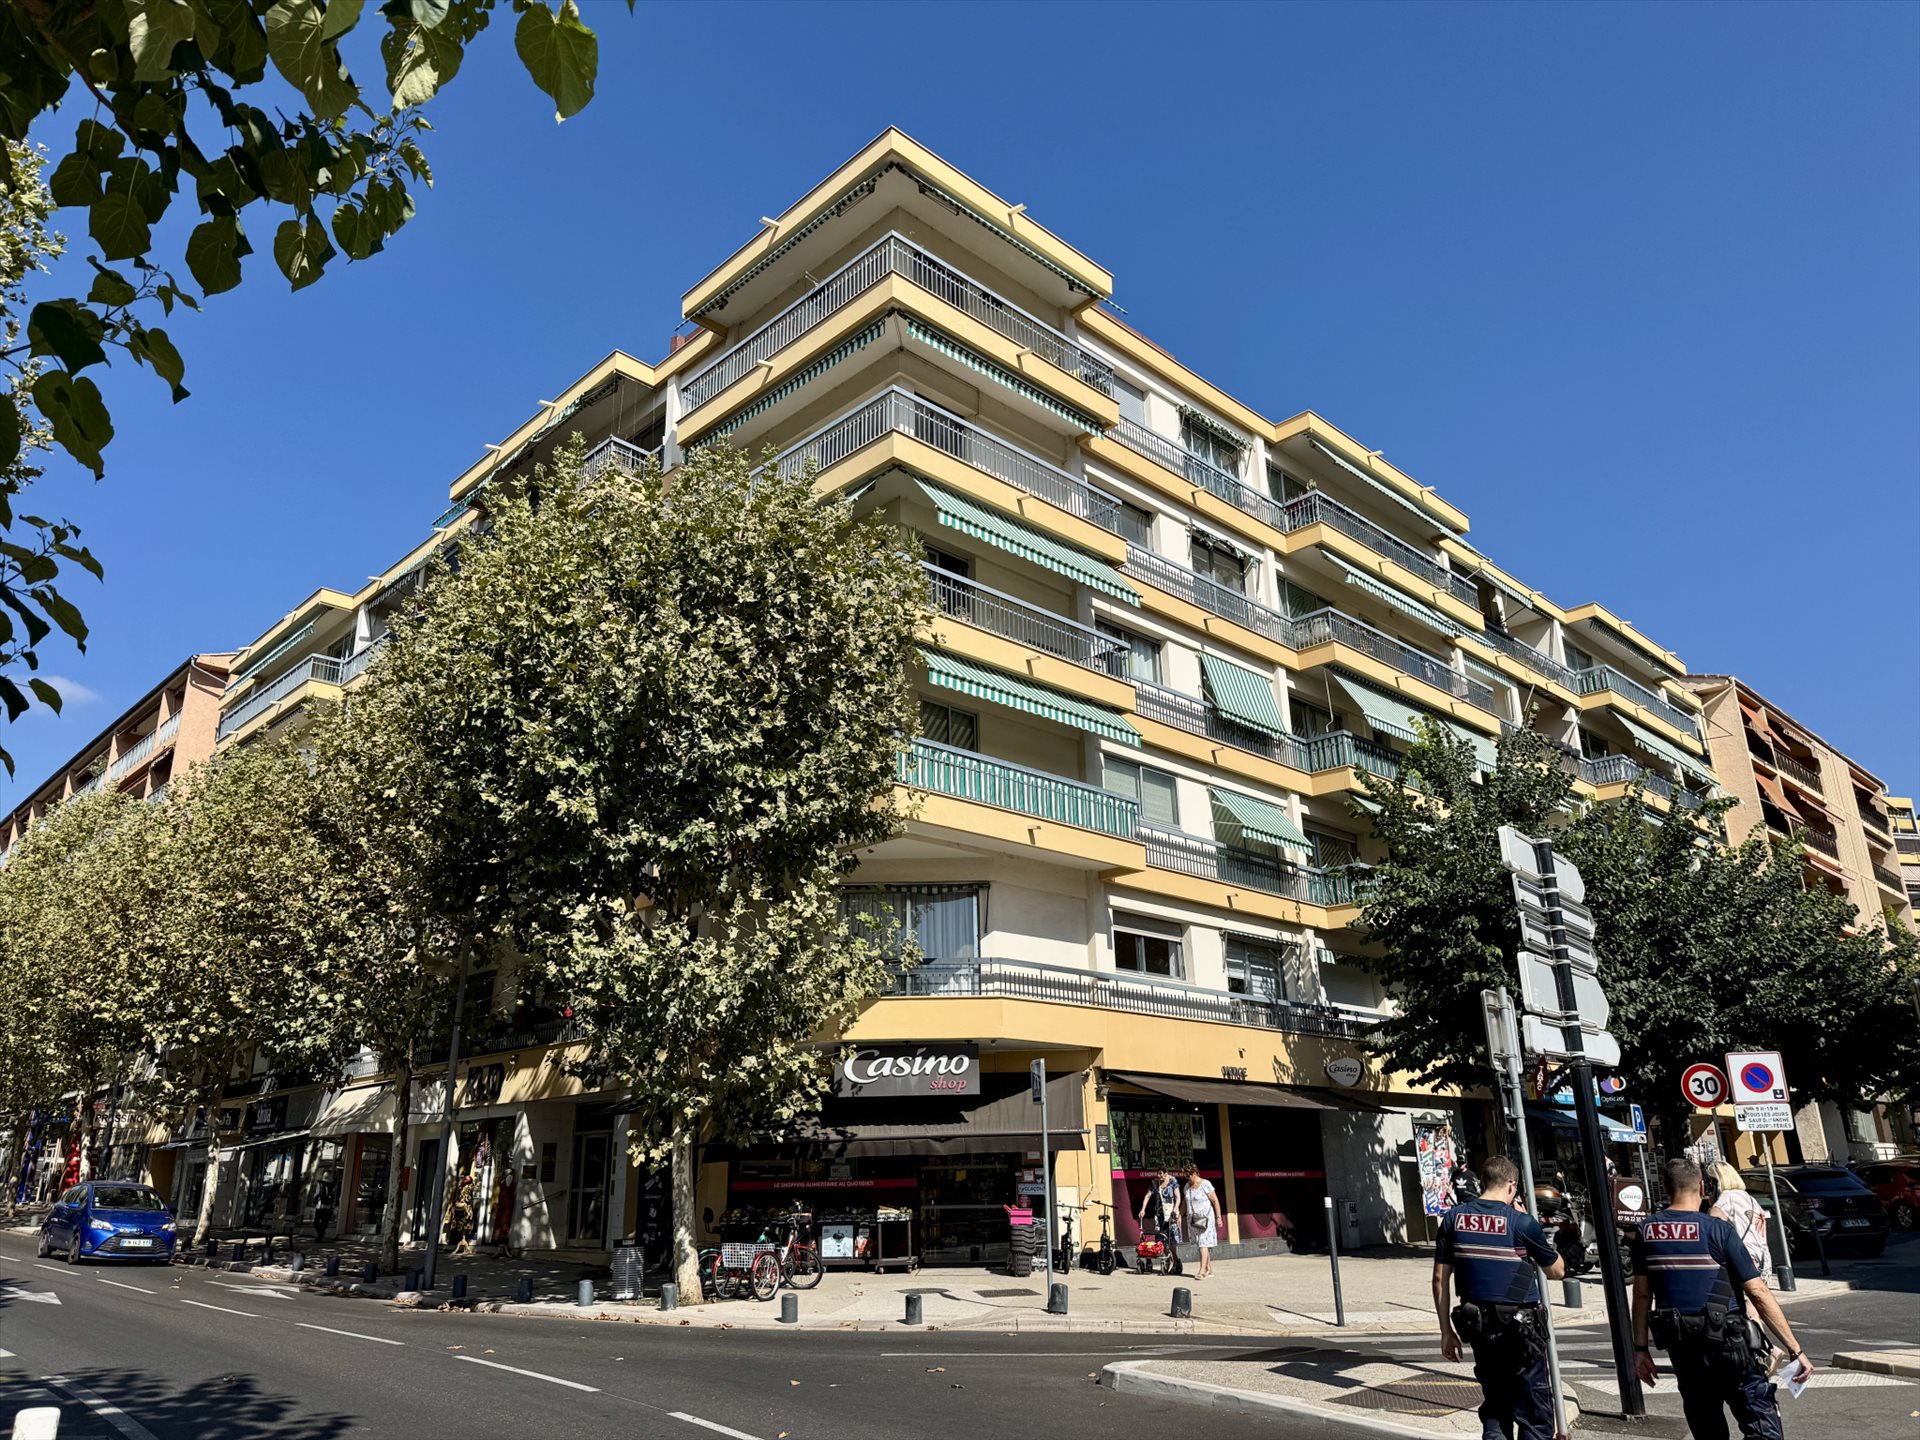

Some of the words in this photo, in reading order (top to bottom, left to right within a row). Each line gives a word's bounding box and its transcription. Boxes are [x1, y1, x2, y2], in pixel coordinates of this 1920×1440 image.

[843, 1047, 970, 1084] Casino
[1329, 1064, 1358, 1074] Casino
[929, 1076, 967, 1093] shop
[1536, 1065, 1544, 1091] TABAC
[1691, 1077, 1719, 1095] 30
[94, 1113, 144, 1123] PRSSING
[1634, 1110, 1641, 1131] P
[1456, 1215, 1505, 1233] A.S.V.P.
[1646, 1223, 1698, 1239] A.S.V.P.
